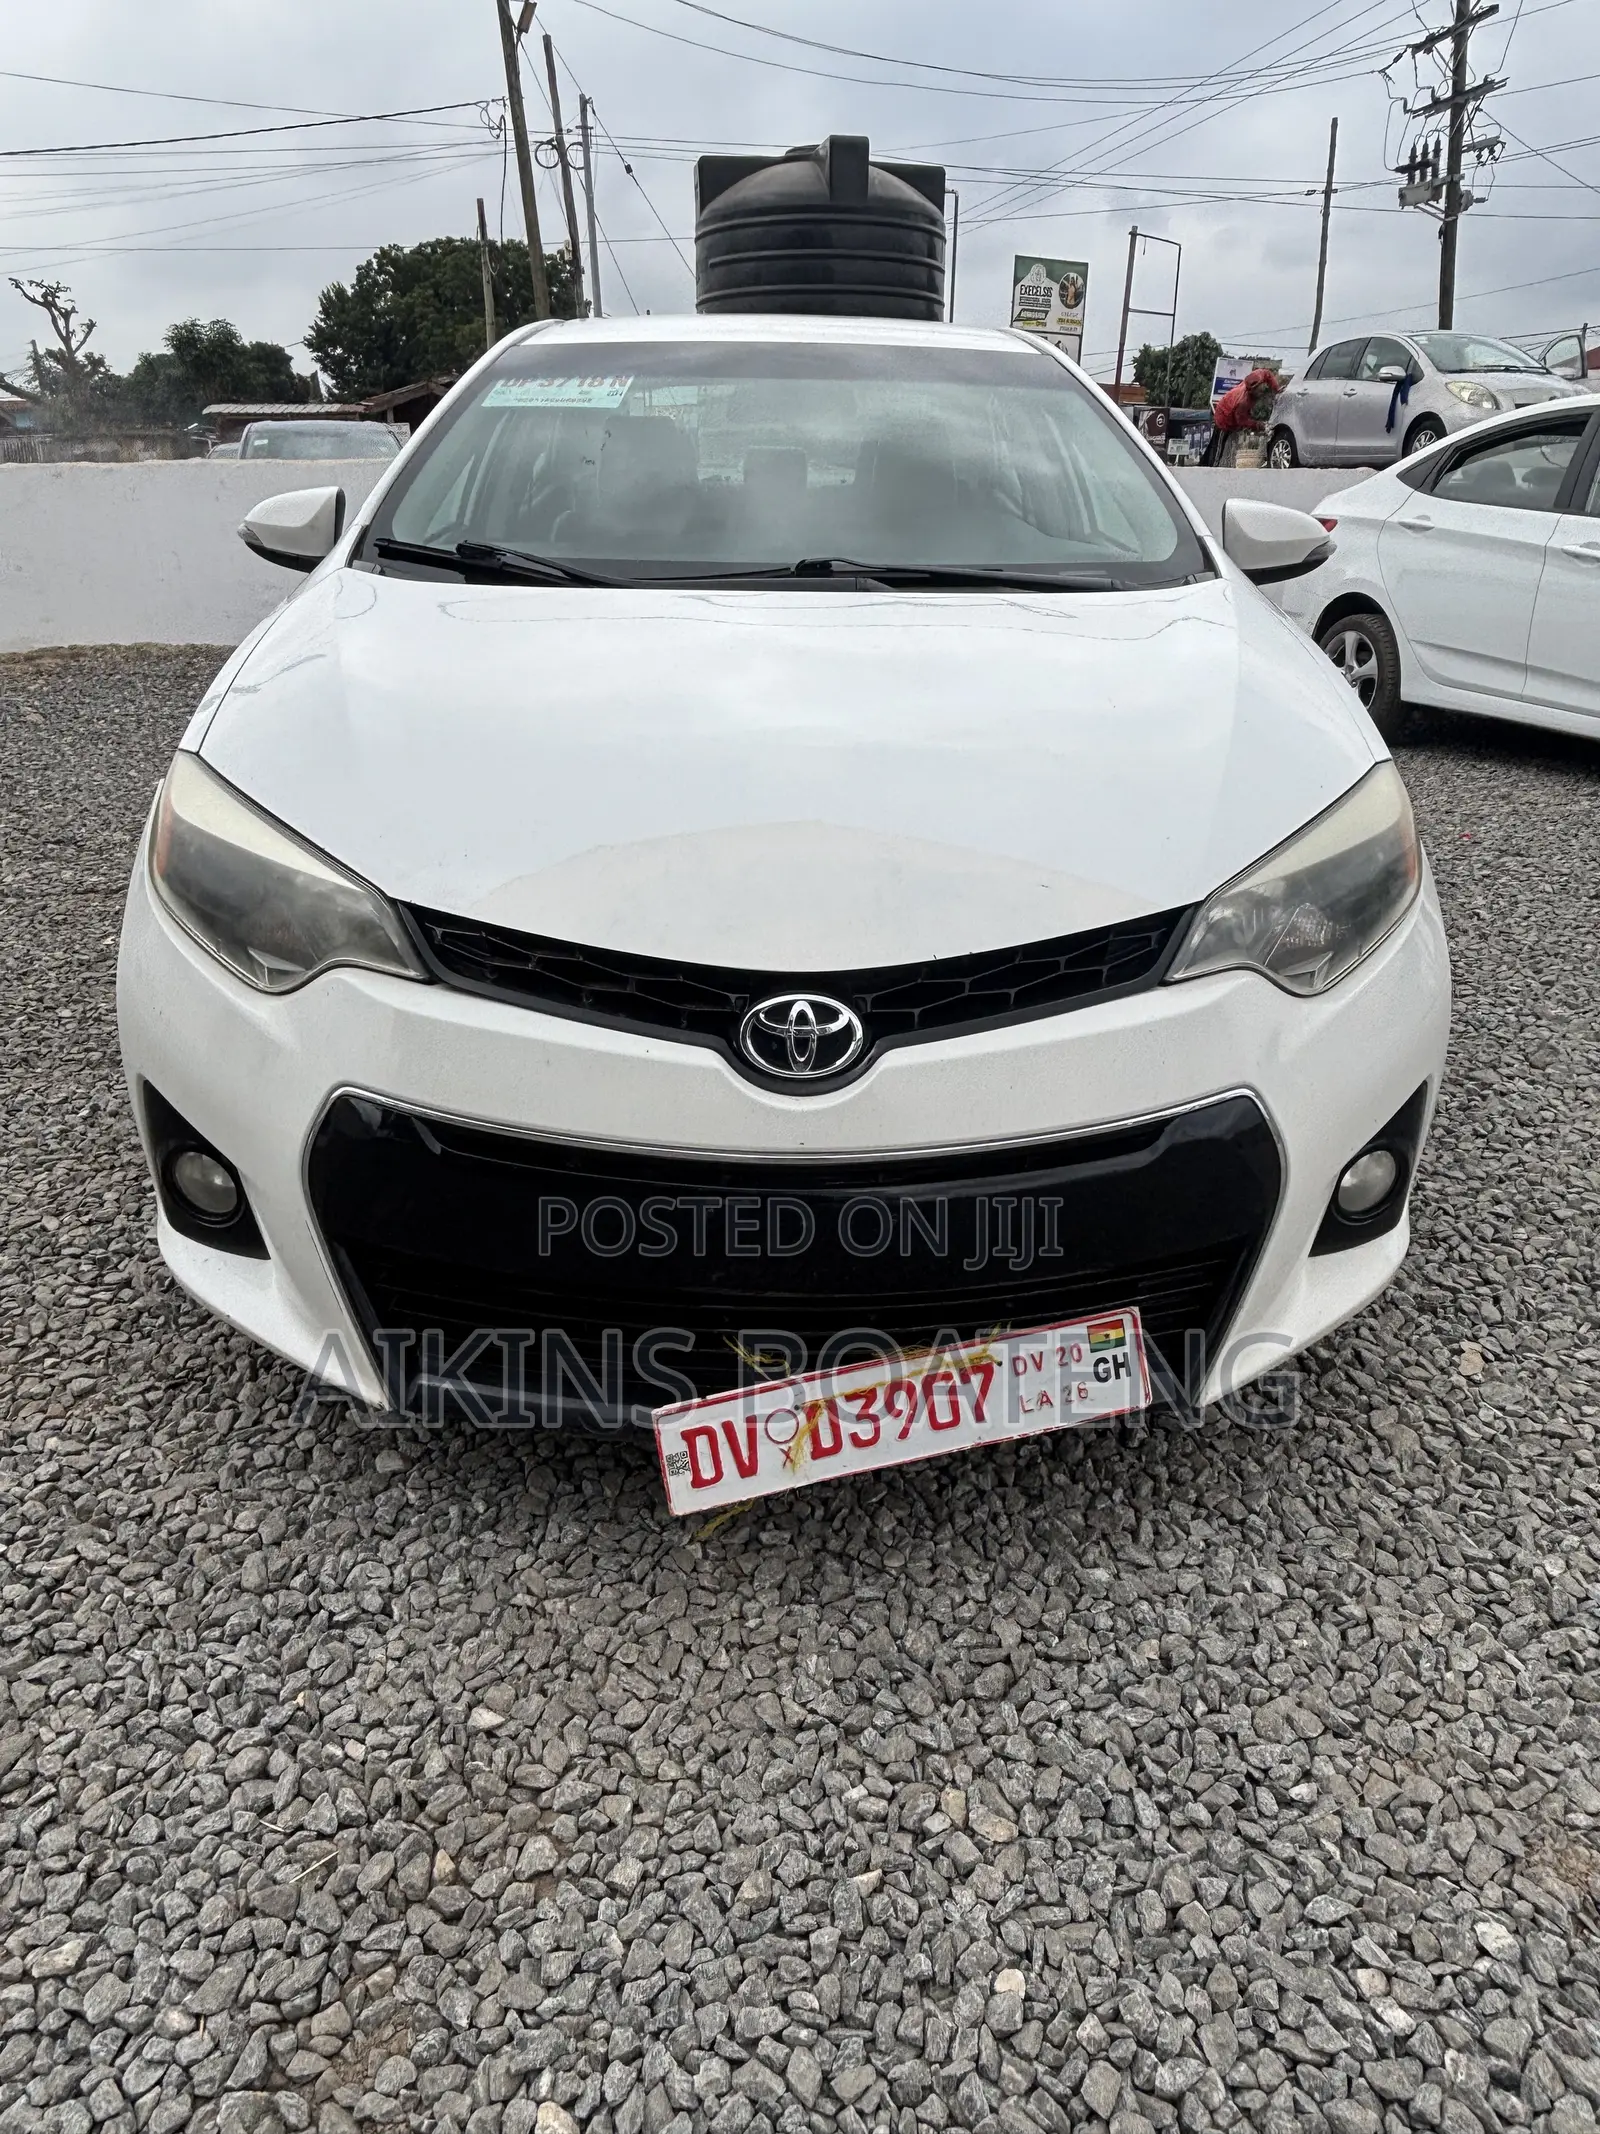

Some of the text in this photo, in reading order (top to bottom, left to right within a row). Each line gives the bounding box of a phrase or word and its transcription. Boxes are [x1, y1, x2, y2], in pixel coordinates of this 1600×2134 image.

[1012, 1342, 1083, 1377] DV 20
[1093, 1352, 1132, 1383] GH
[1019, 1381, 1089, 1414] LA 26
[680, 1413, 759, 1489] DV
